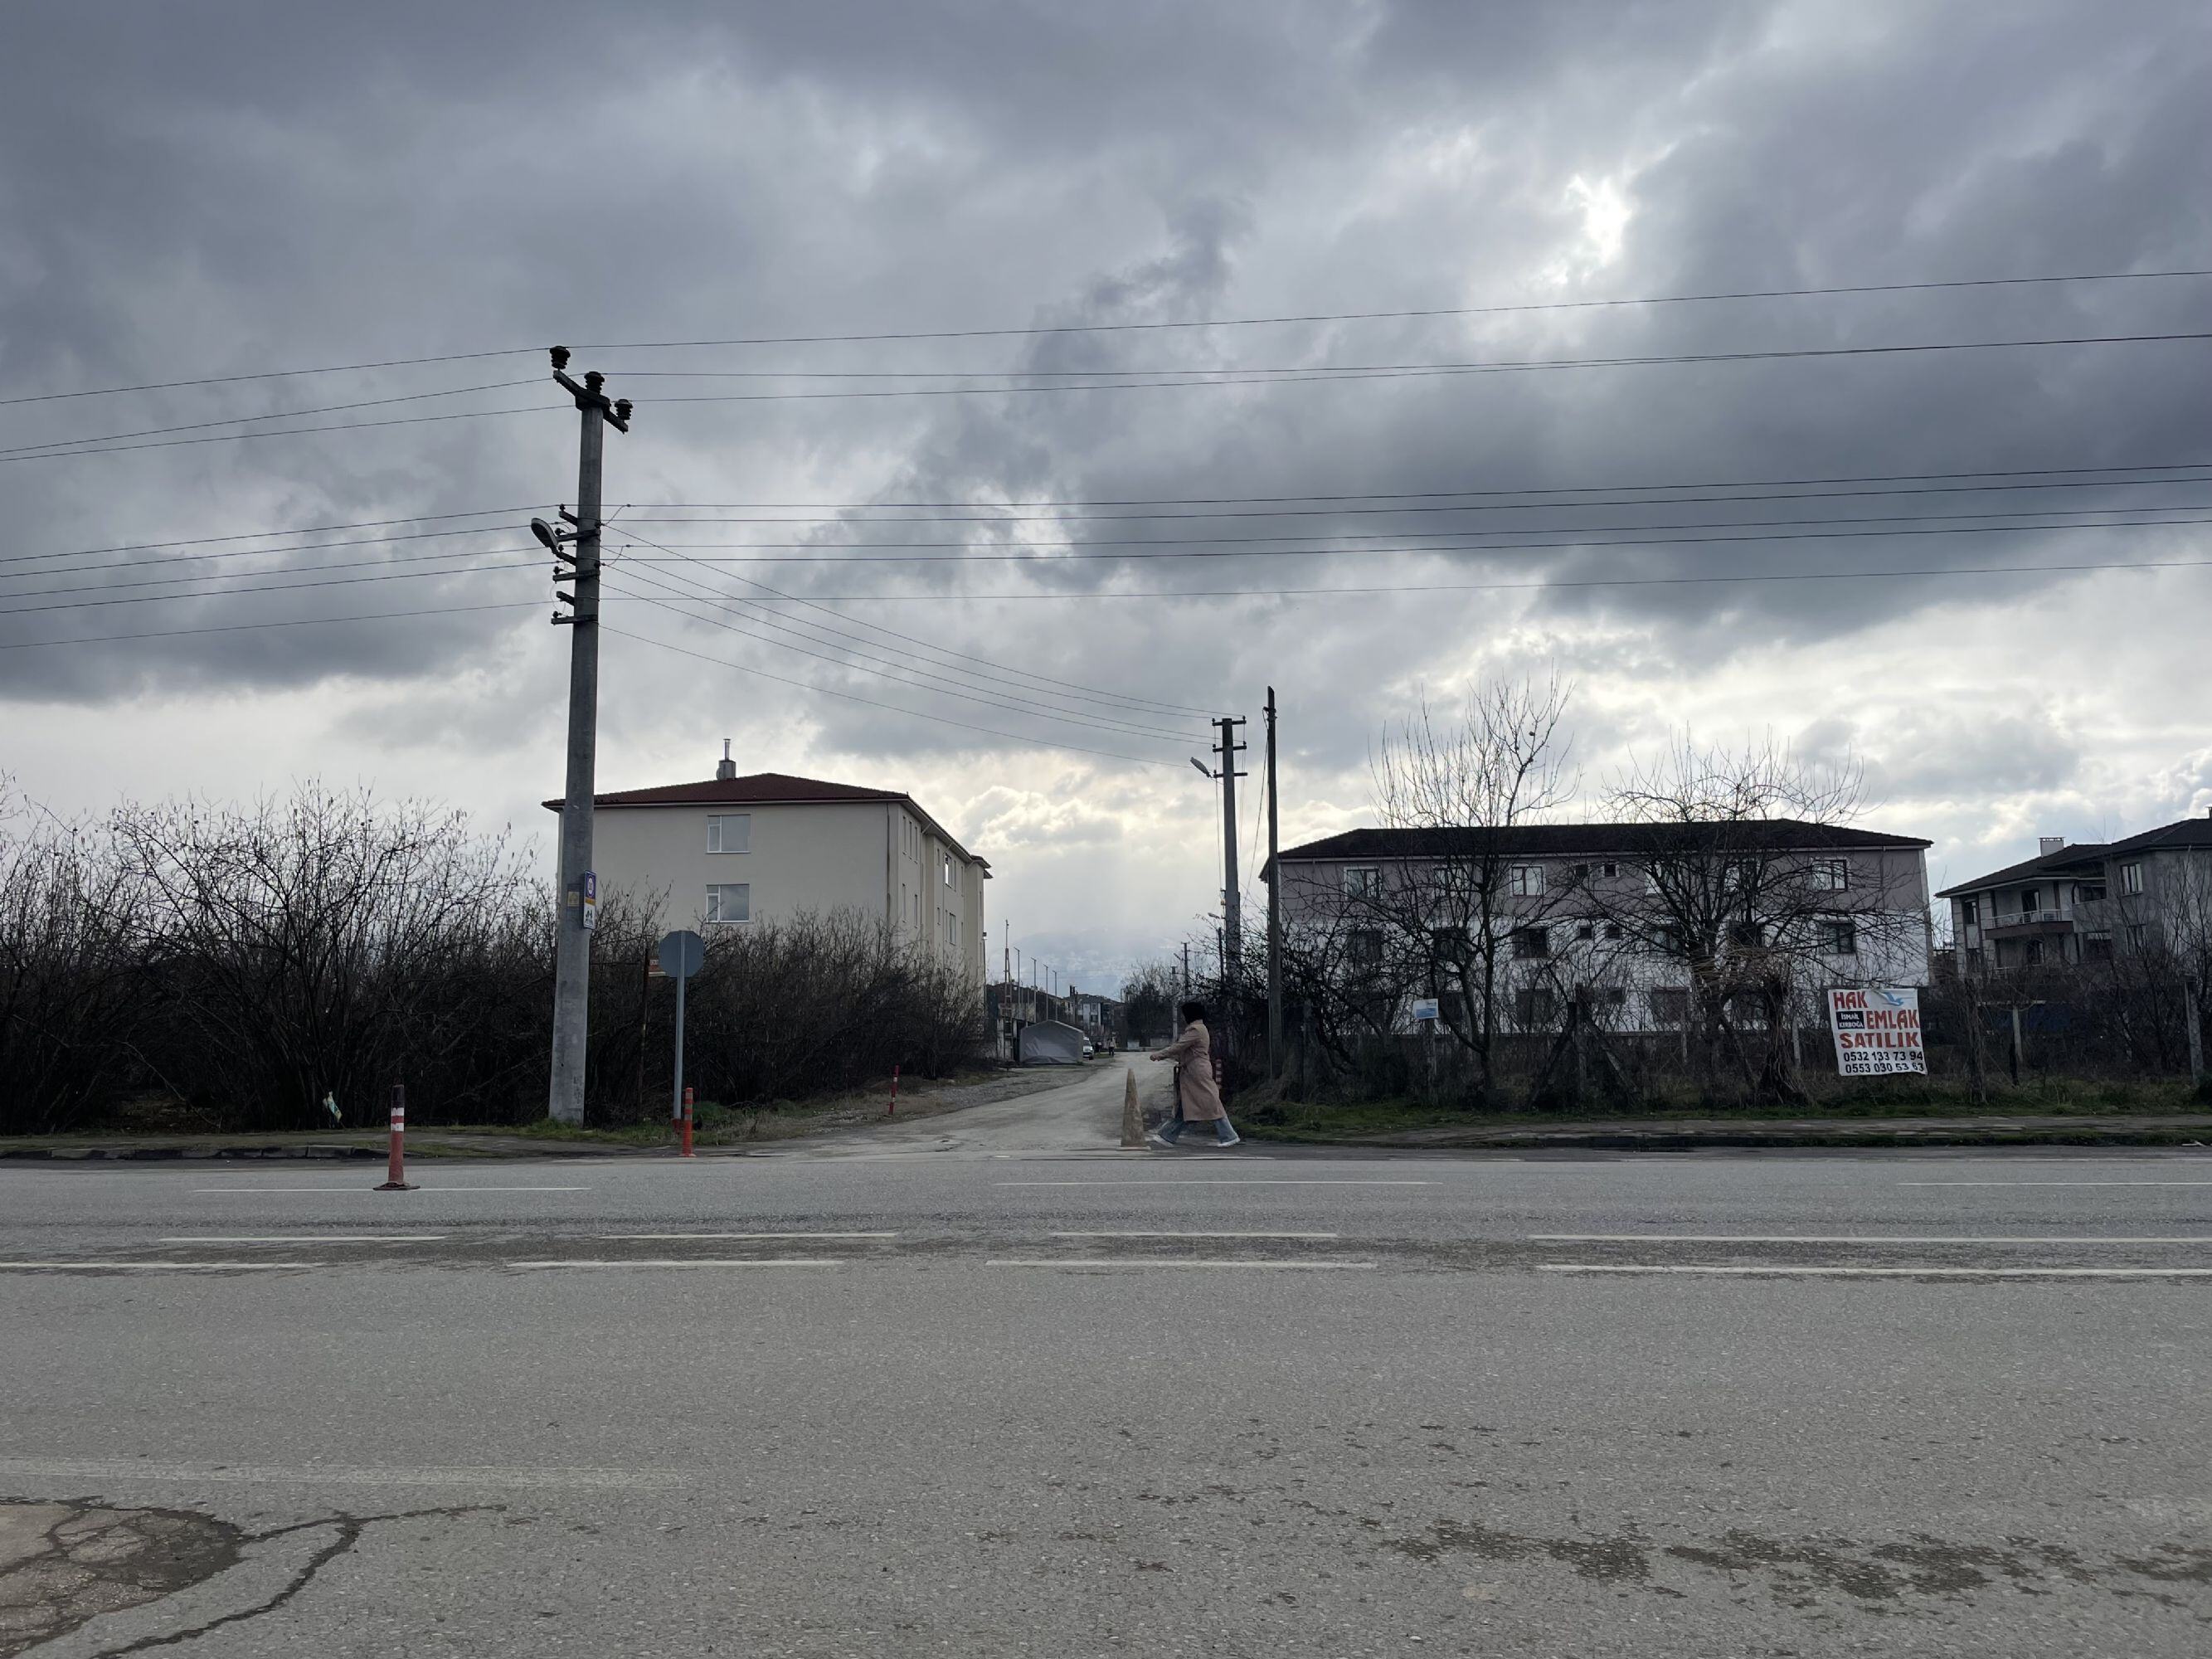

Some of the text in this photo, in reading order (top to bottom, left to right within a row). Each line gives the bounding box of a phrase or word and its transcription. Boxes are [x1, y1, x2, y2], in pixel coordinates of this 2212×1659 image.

[1833, 991, 1868, 1010] HAK
[1866, 1010, 1919, 1029] EMLAK
[1840, 1032, 1919, 1048] SATILIK
[1844, 1052, 1923, 1062] 0532 133 73 94
[1845, 1063, 1871, 1073] 0553
[1874, 1063, 1893, 1073] 030
[1896, 1063, 1909, 1071] 53
